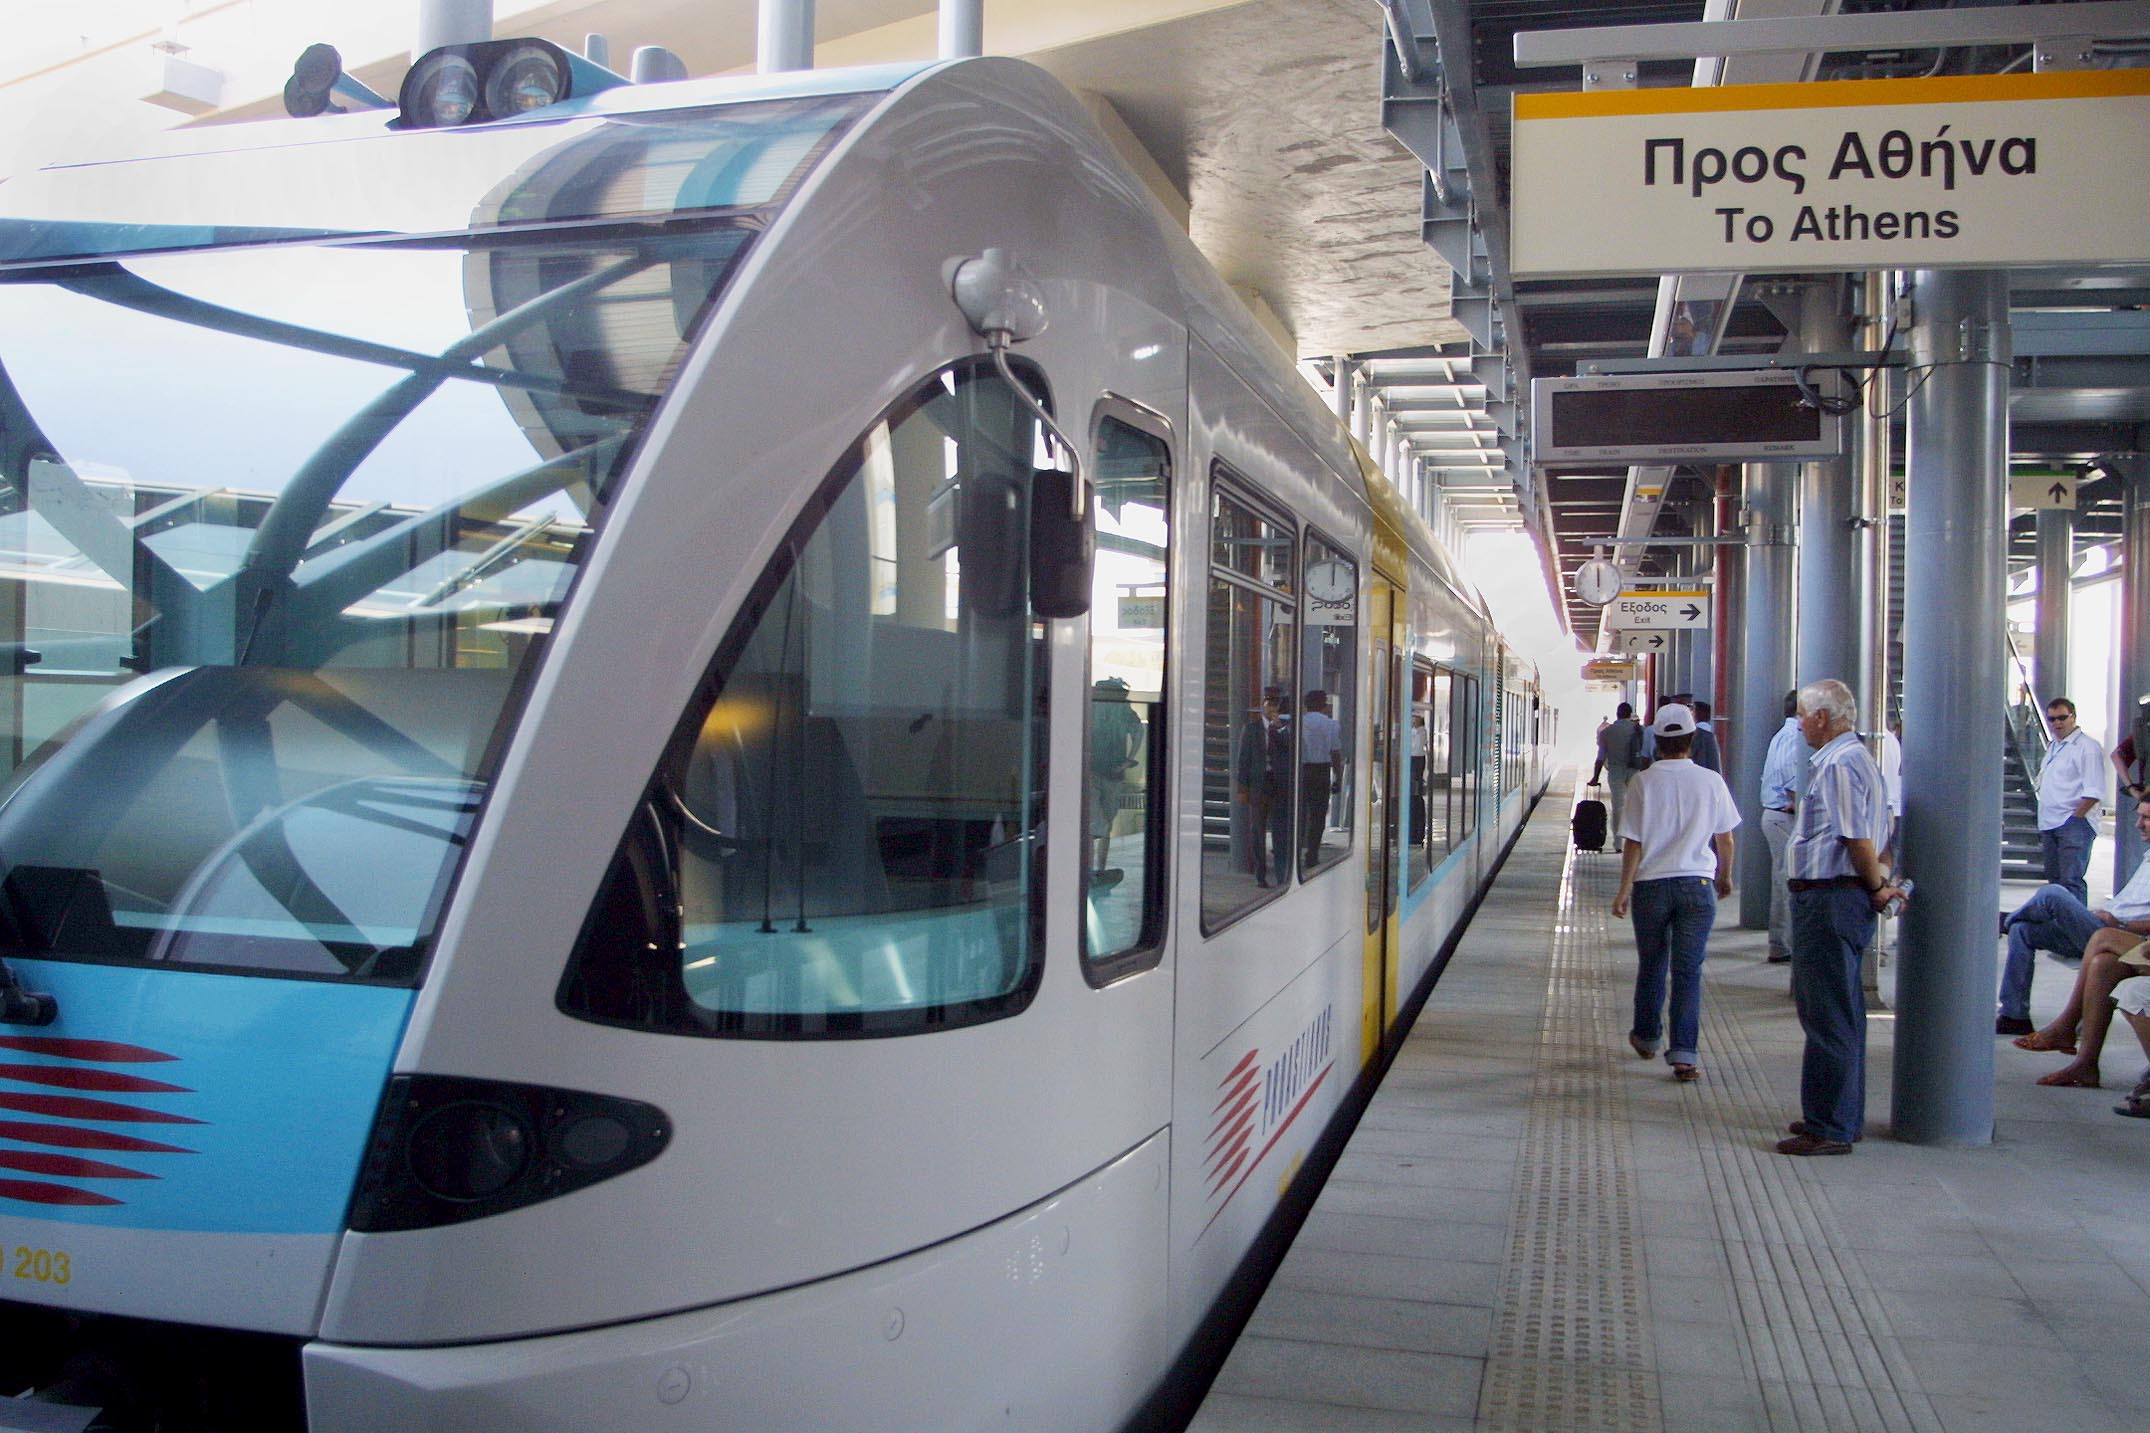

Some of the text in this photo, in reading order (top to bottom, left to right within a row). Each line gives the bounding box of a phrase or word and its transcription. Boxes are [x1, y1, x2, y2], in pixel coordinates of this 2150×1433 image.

[1645, 124, 2038, 197] Προς Αθήνα
[1715, 204, 1961, 244] To Athens
[1634, 616, 1651, 624] Exit
[14, 1246, 72, 1285] 203
